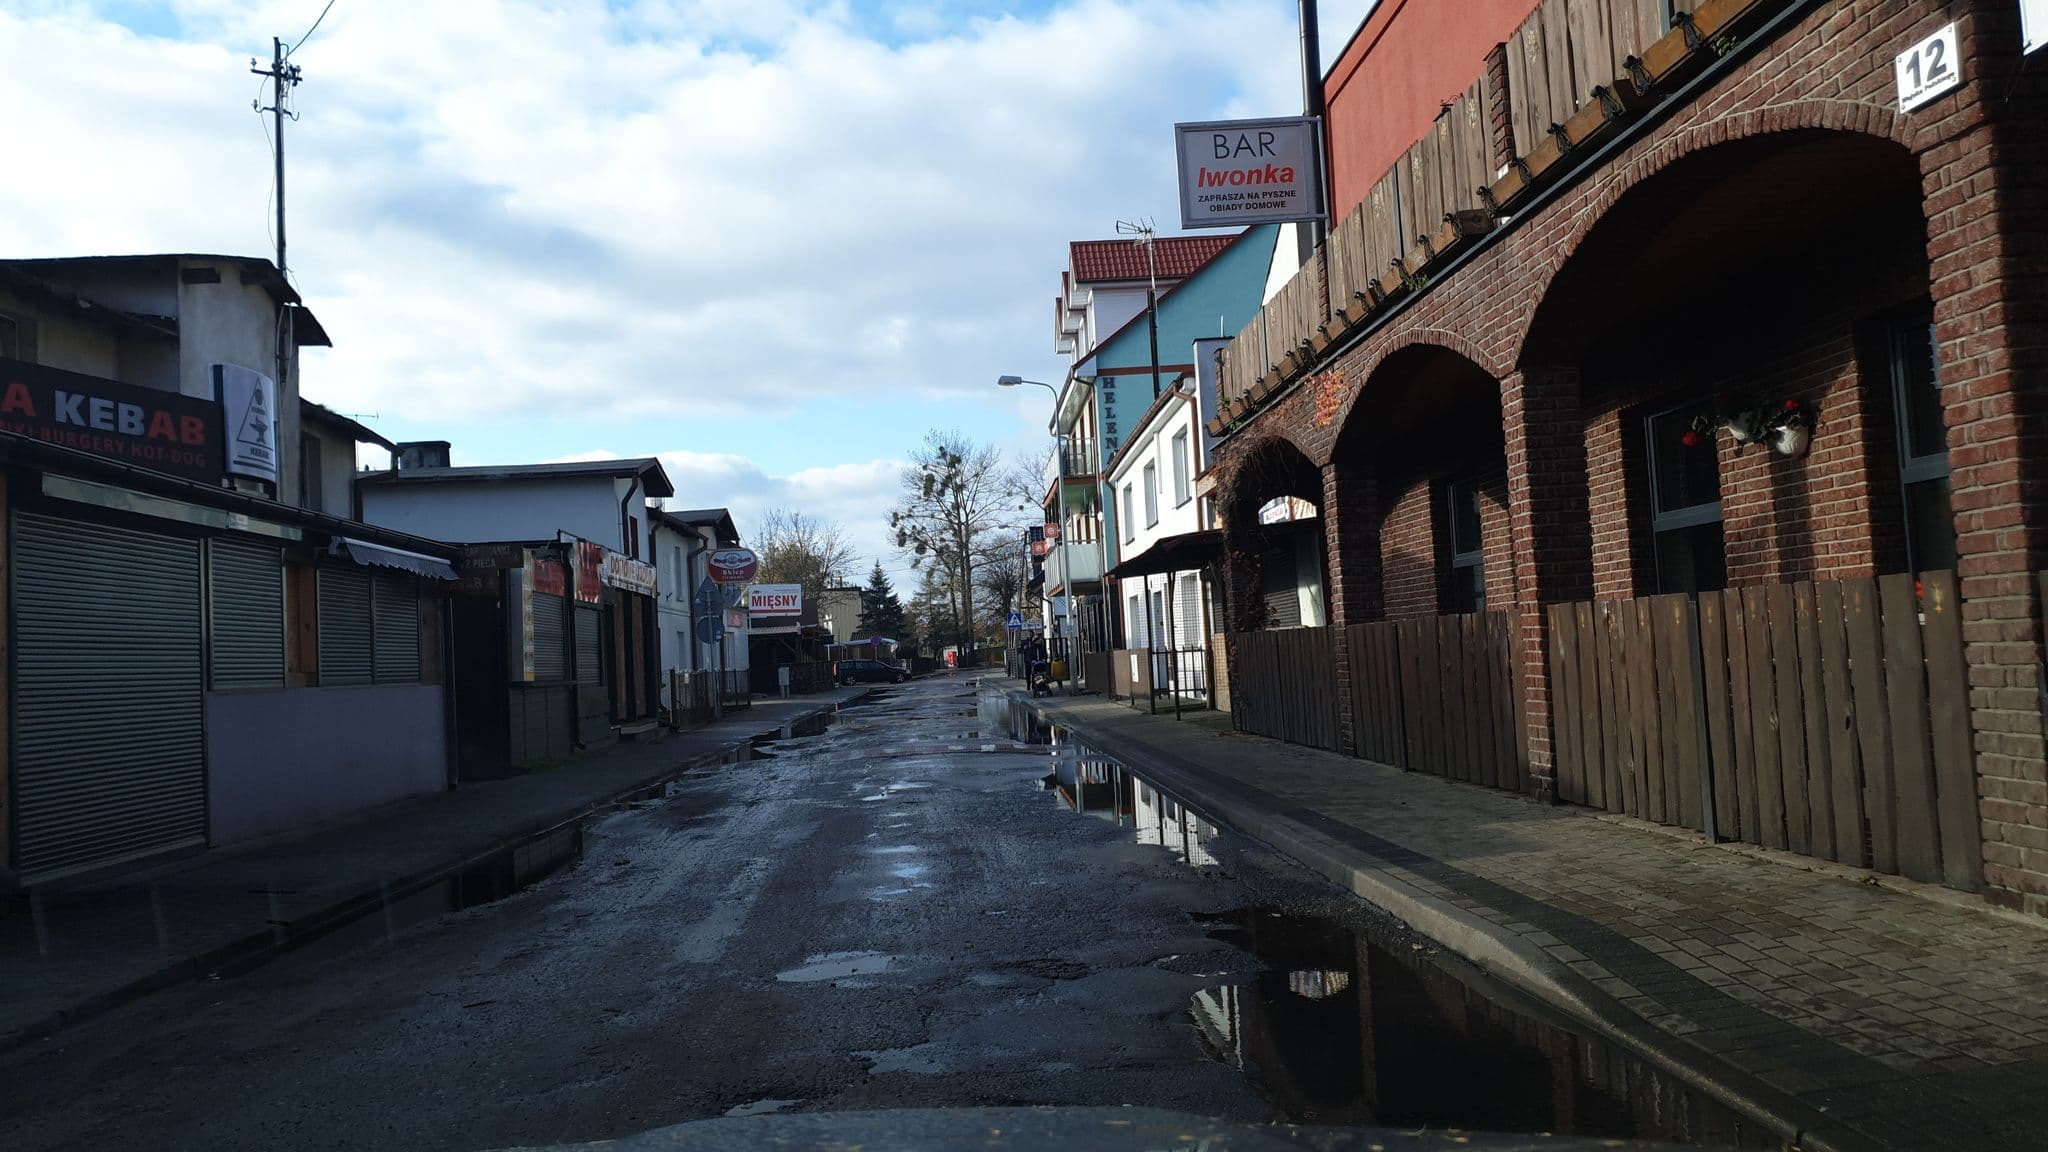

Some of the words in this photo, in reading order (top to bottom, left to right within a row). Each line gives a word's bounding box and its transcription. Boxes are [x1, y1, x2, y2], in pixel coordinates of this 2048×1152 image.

[1906, 38, 1947, 89] 12
[1213, 131, 1276, 160] BAR
[1197, 163, 1295, 188] Iwonka
[1198, 191, 1245, 203] ZAPRASZA
[1248, 191, 1260, 200] NA
[1262, 190, 1296, 199] PYSZNE
[1209, 203, 1244, 212] OBIADY
[1246, 201, 1287, 210] DOMOWE
[54, 390, 206, 446] KEBAB
[752, 594, 797, 609] MIĘSNY
